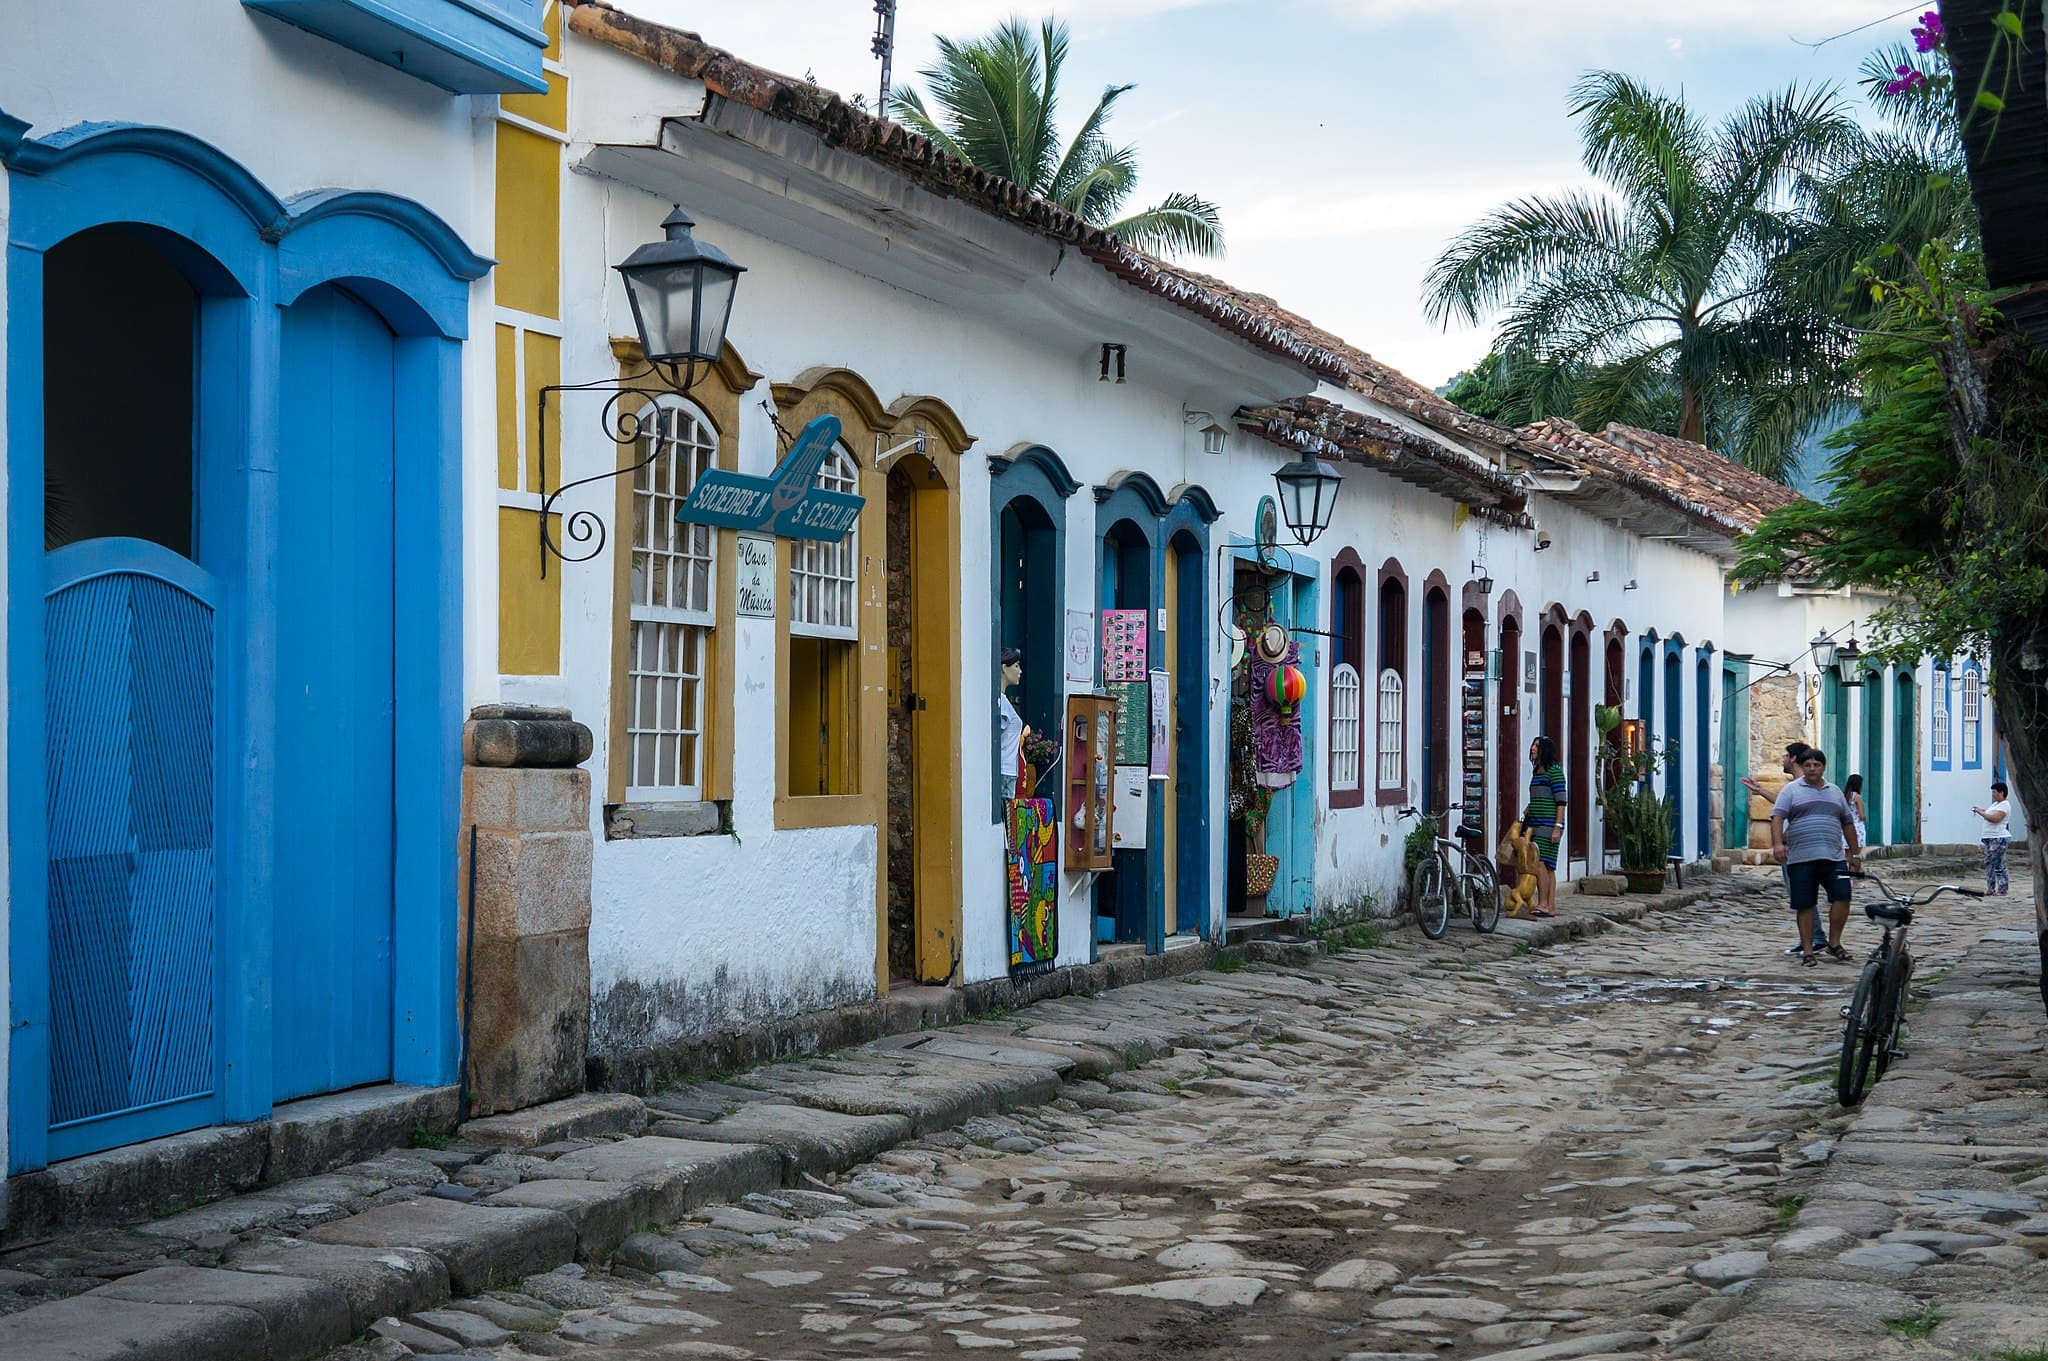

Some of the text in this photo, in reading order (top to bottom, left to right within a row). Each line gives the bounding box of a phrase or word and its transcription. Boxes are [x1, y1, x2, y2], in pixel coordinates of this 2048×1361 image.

[693, 483, 760, 516] SOCIEDADE
[805, 502, 857, 531] CECILIA
[745, 542, 767, 566] Casa
[752, 571, 761, 586] da
[740, 587, 772, 611] Música
